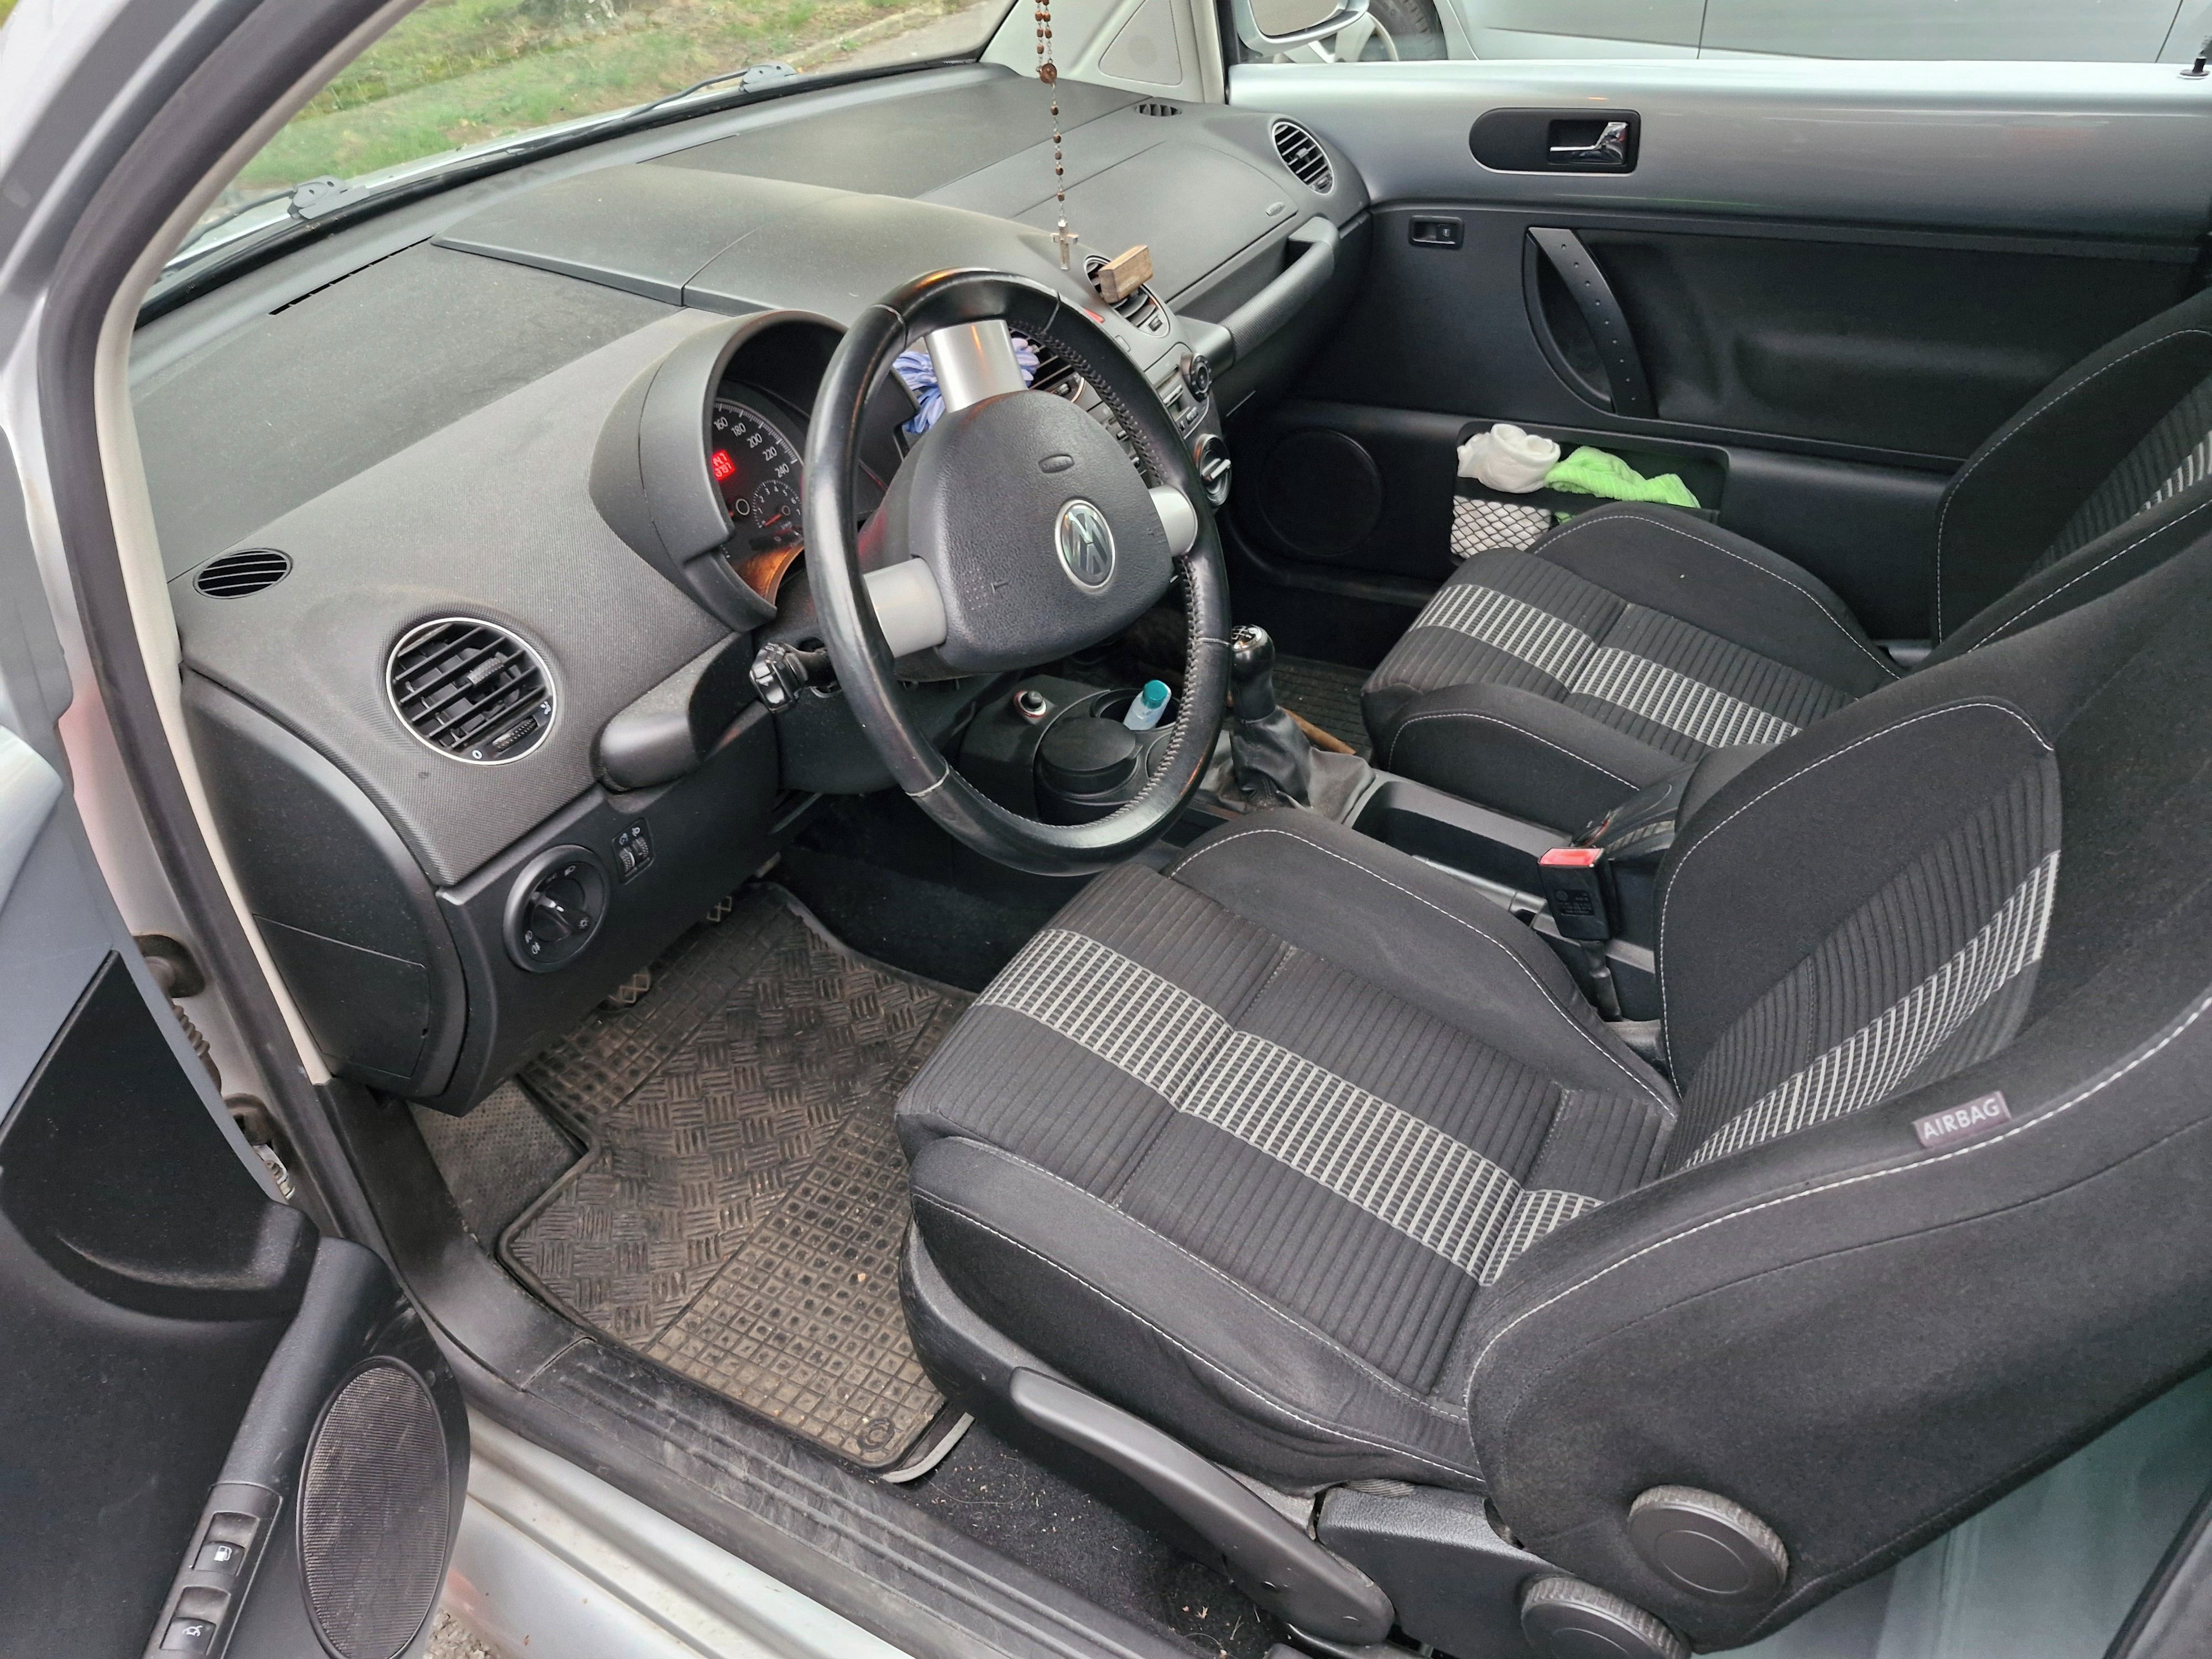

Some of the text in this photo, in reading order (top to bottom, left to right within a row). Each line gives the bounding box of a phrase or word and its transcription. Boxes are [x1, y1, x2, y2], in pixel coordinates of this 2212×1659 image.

[713, 416, 728, 431] 160
[731, 422, 746, 437] 180
[747, 433, 763, 448] 200
[762, 446, 778, 461] 220
[774, 463, 790, 478] 240
[1923, 1098, 2000, 1140] AIRBAG
